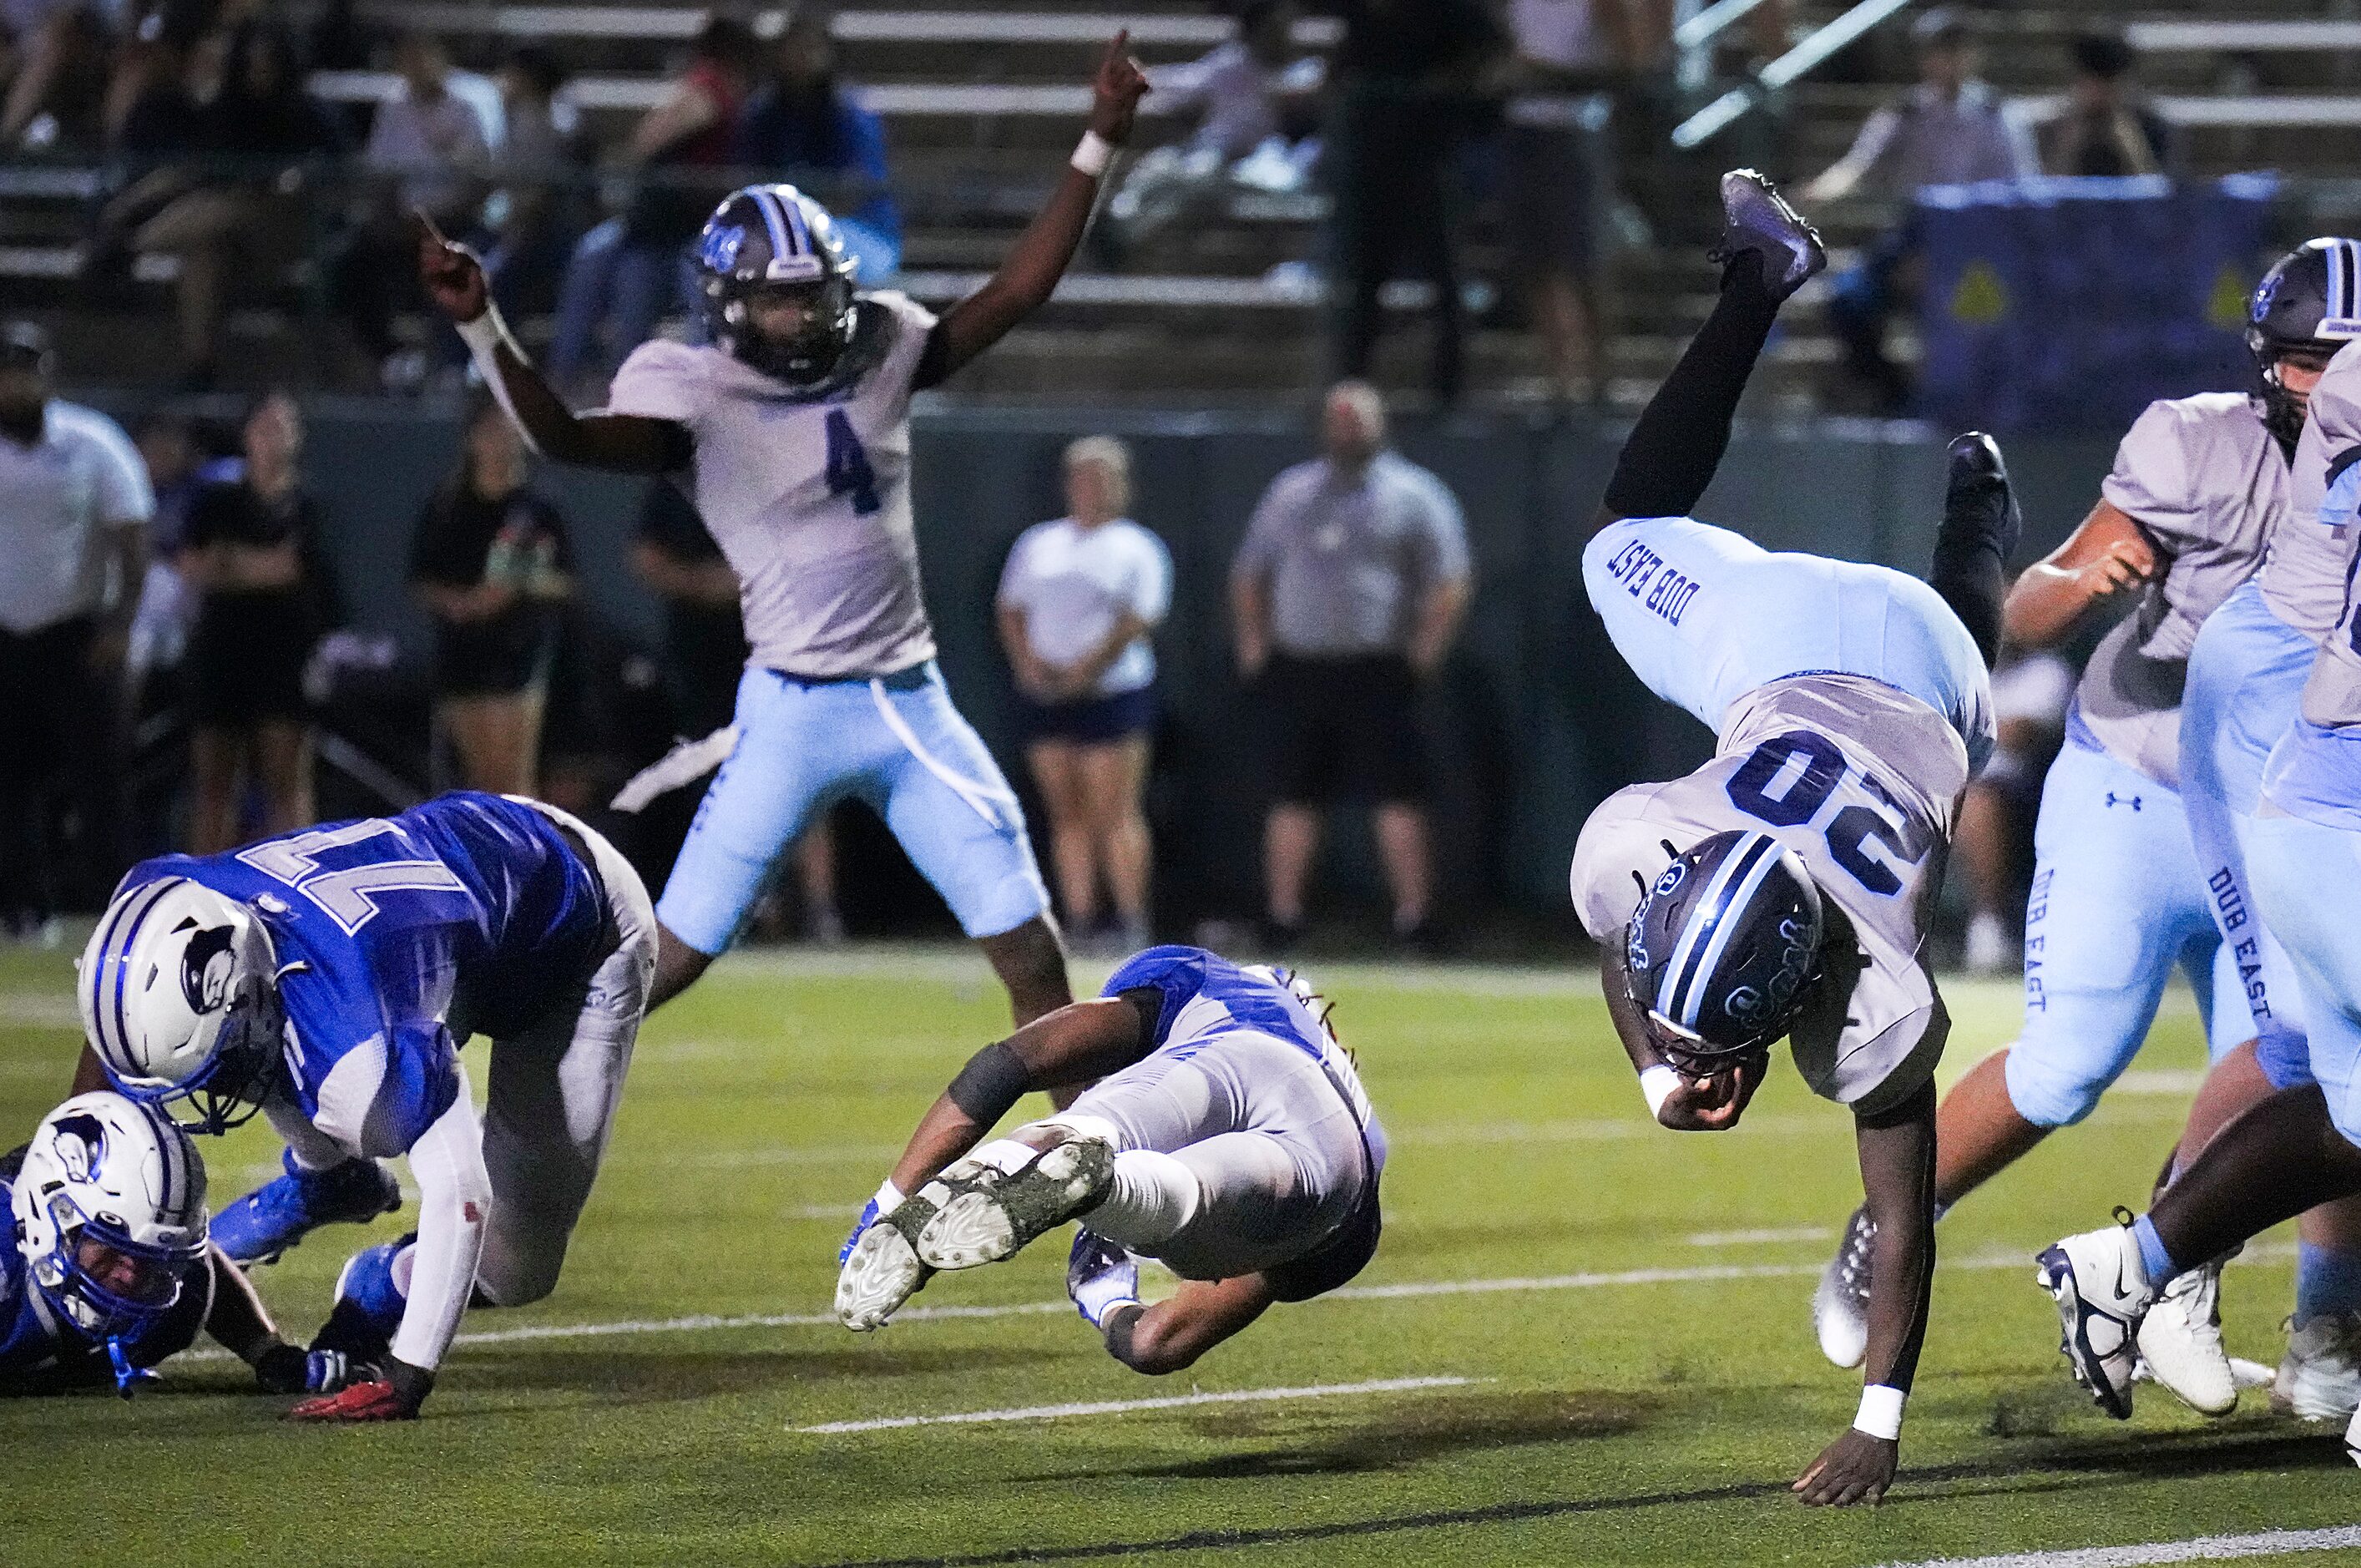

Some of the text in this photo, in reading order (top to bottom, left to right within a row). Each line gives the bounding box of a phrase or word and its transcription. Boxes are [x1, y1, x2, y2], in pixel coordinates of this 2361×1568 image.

[823, 407, 882, 515] 4
[1606, 539, 1701, 627] DUB EAST
[1725, 729, 1933, 897] 20
[235, 817, 468, 938] 77
[2025, 934, 2046, 1013] EAST
[2207, 866, 2273, 1019] DUB EAST
